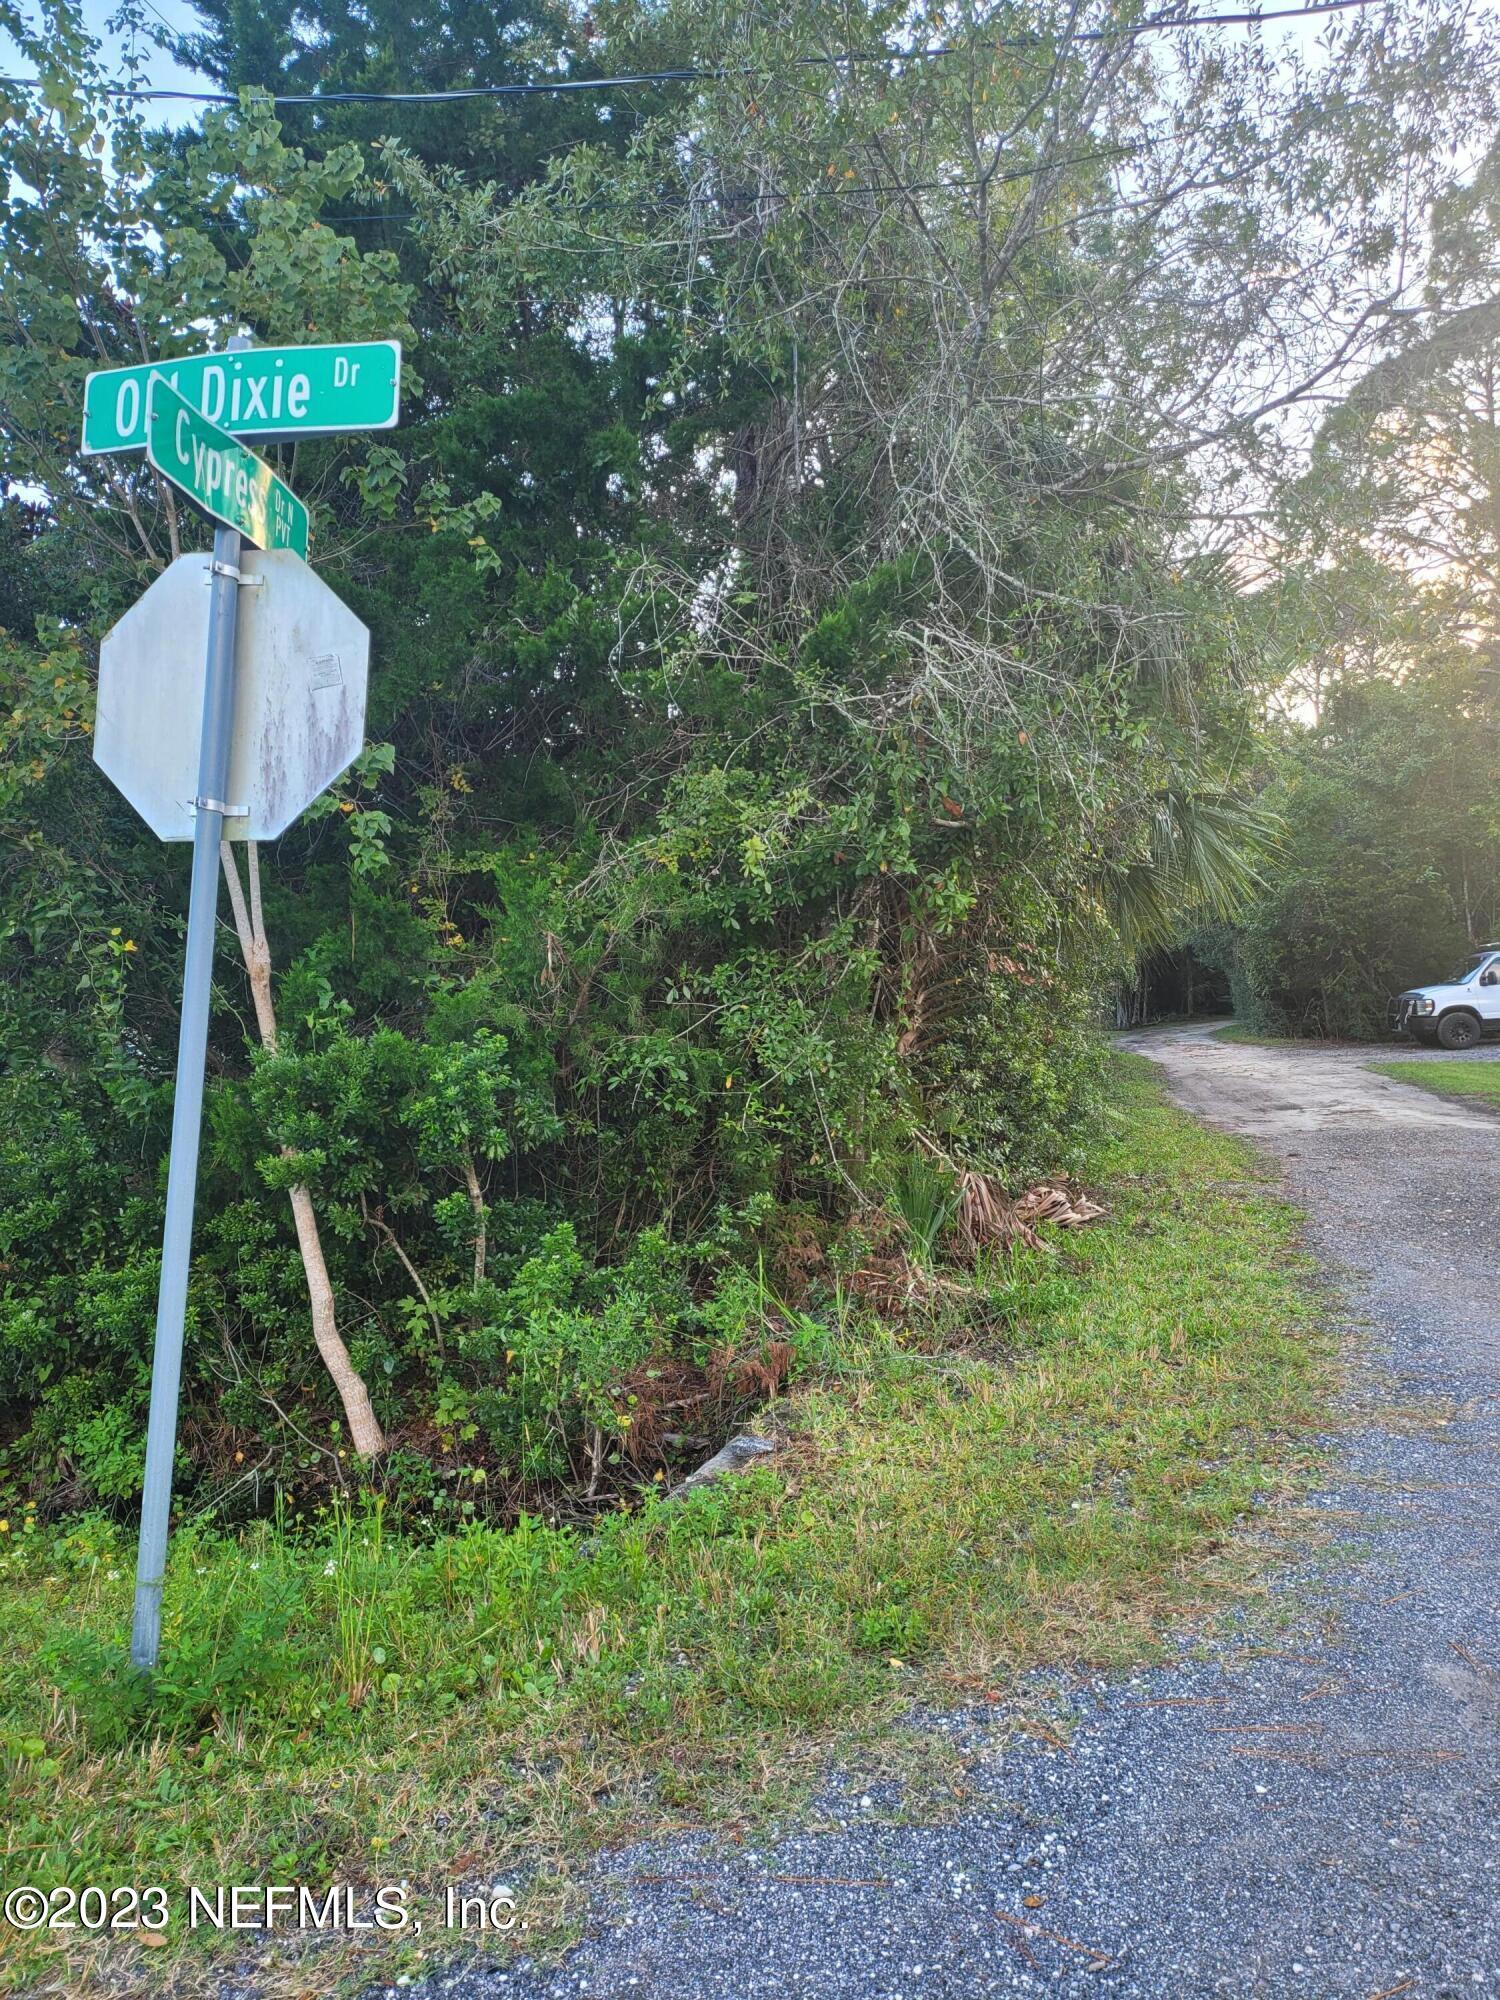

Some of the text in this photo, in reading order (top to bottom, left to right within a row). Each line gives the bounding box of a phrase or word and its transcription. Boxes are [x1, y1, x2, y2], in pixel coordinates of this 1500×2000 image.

[116, 357, 360, 438] Ol Dixie Dr
[176, 408, 294, 526] Cypress Dr N
[275, 515, 291, 547] PVT
